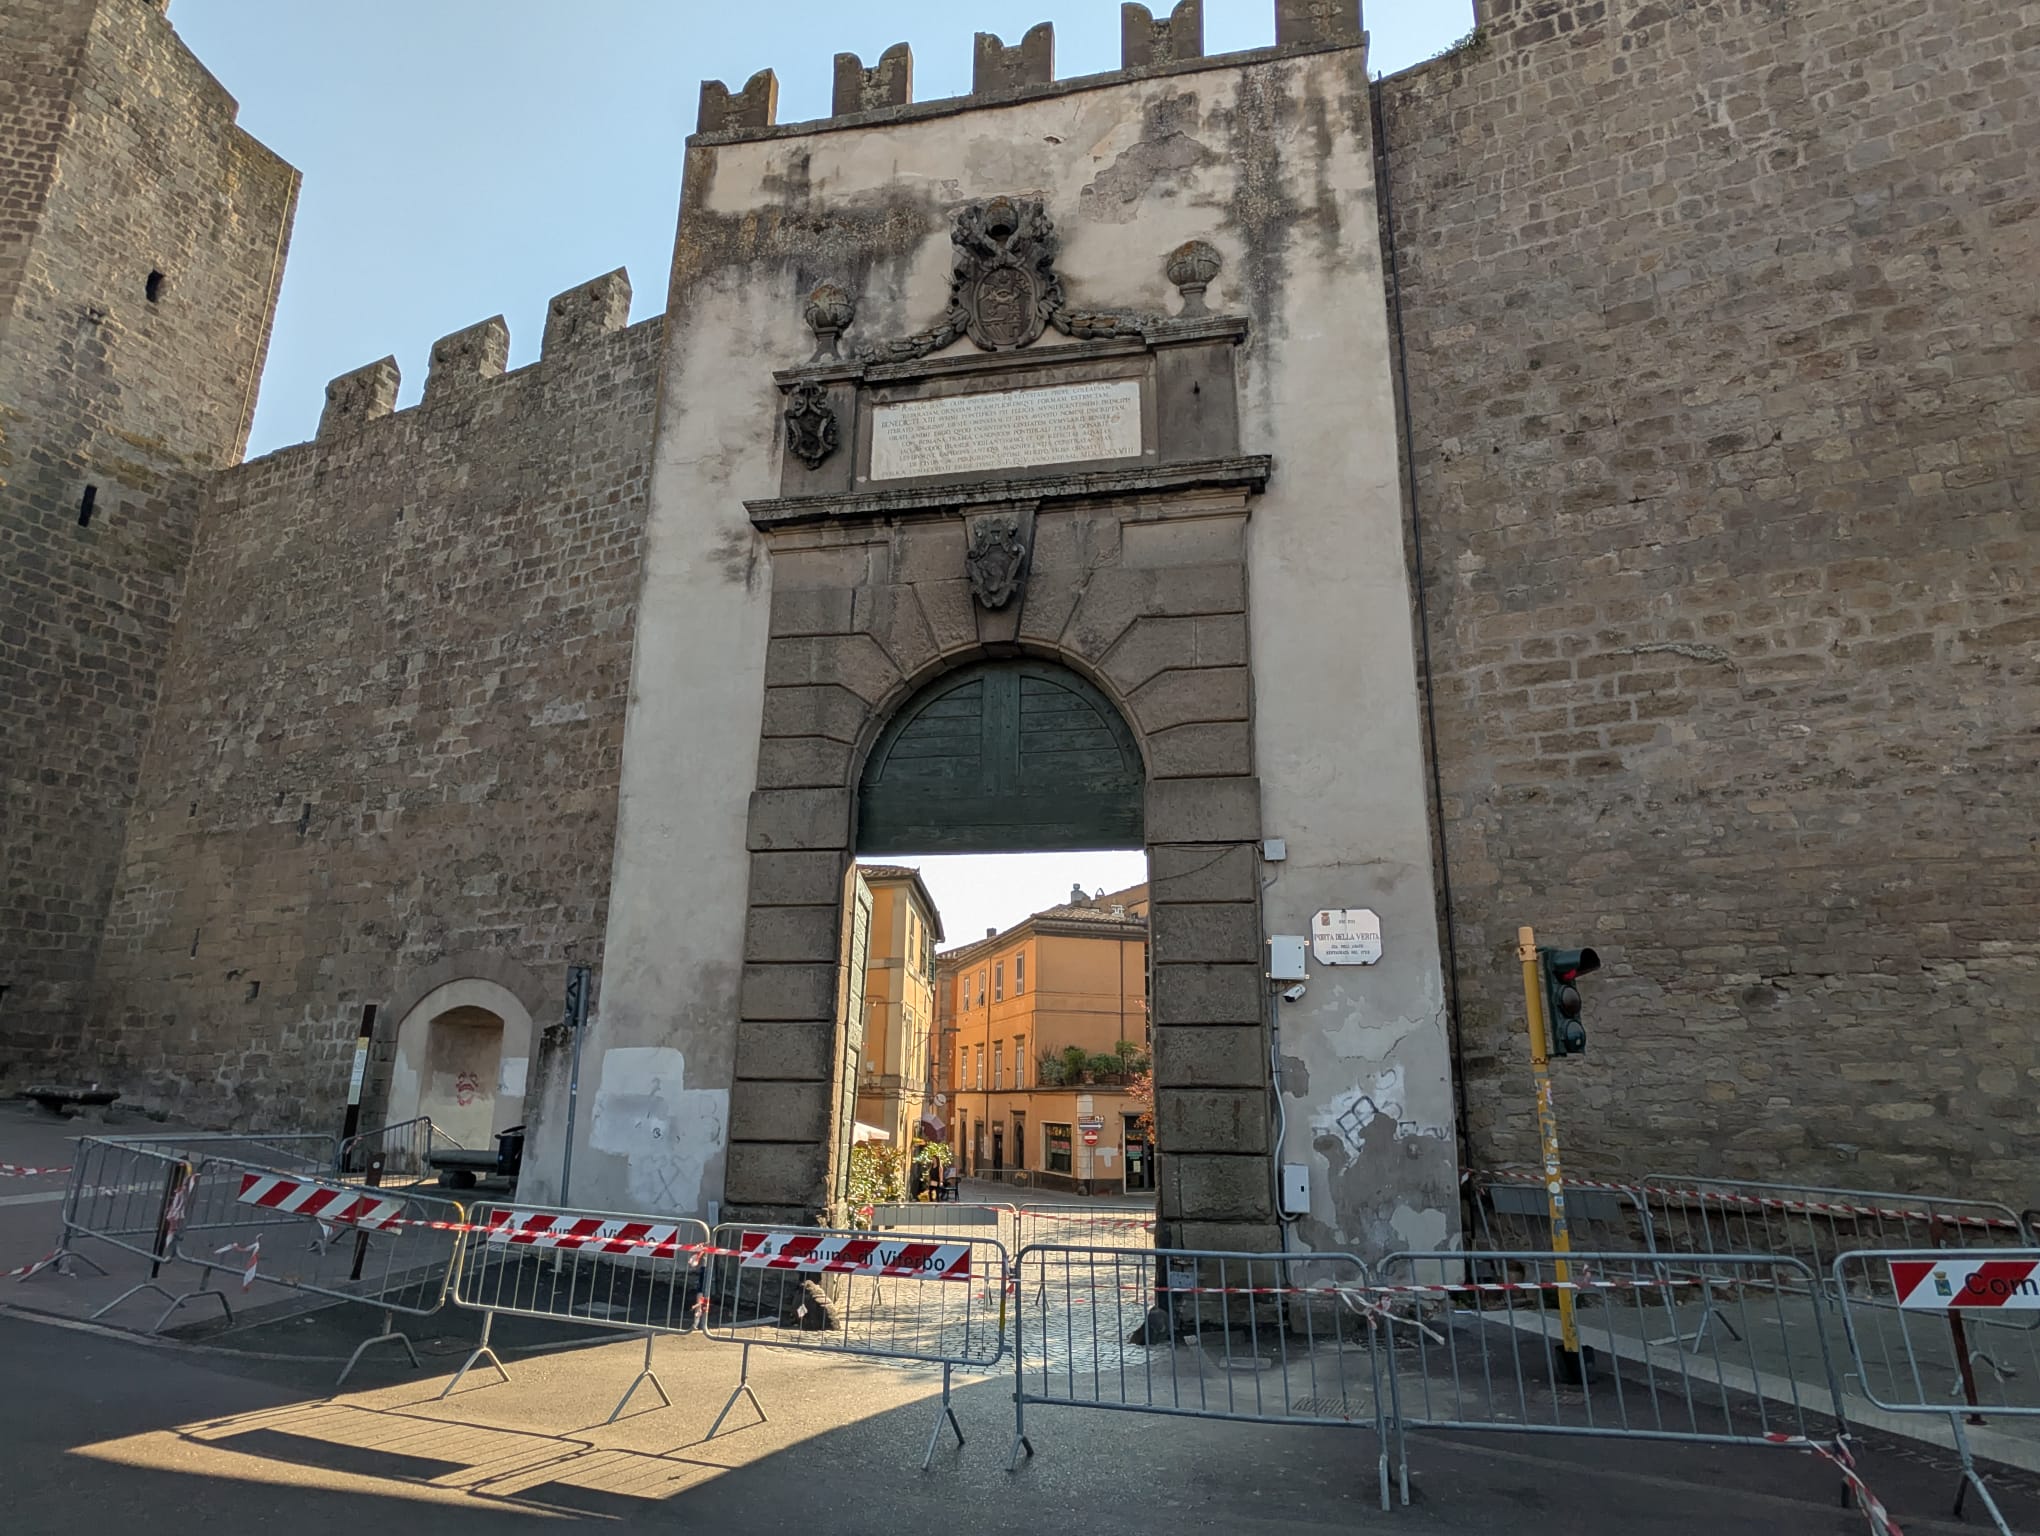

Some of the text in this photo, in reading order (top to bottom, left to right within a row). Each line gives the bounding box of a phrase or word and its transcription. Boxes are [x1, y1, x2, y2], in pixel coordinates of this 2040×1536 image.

[1314, 933, 1334, 941] PORTA
[1335, 933, 1355, 941] DELLA
[857, 1249, 873, 1265] di
[879, 1249, 945, 1271] Viterbo
